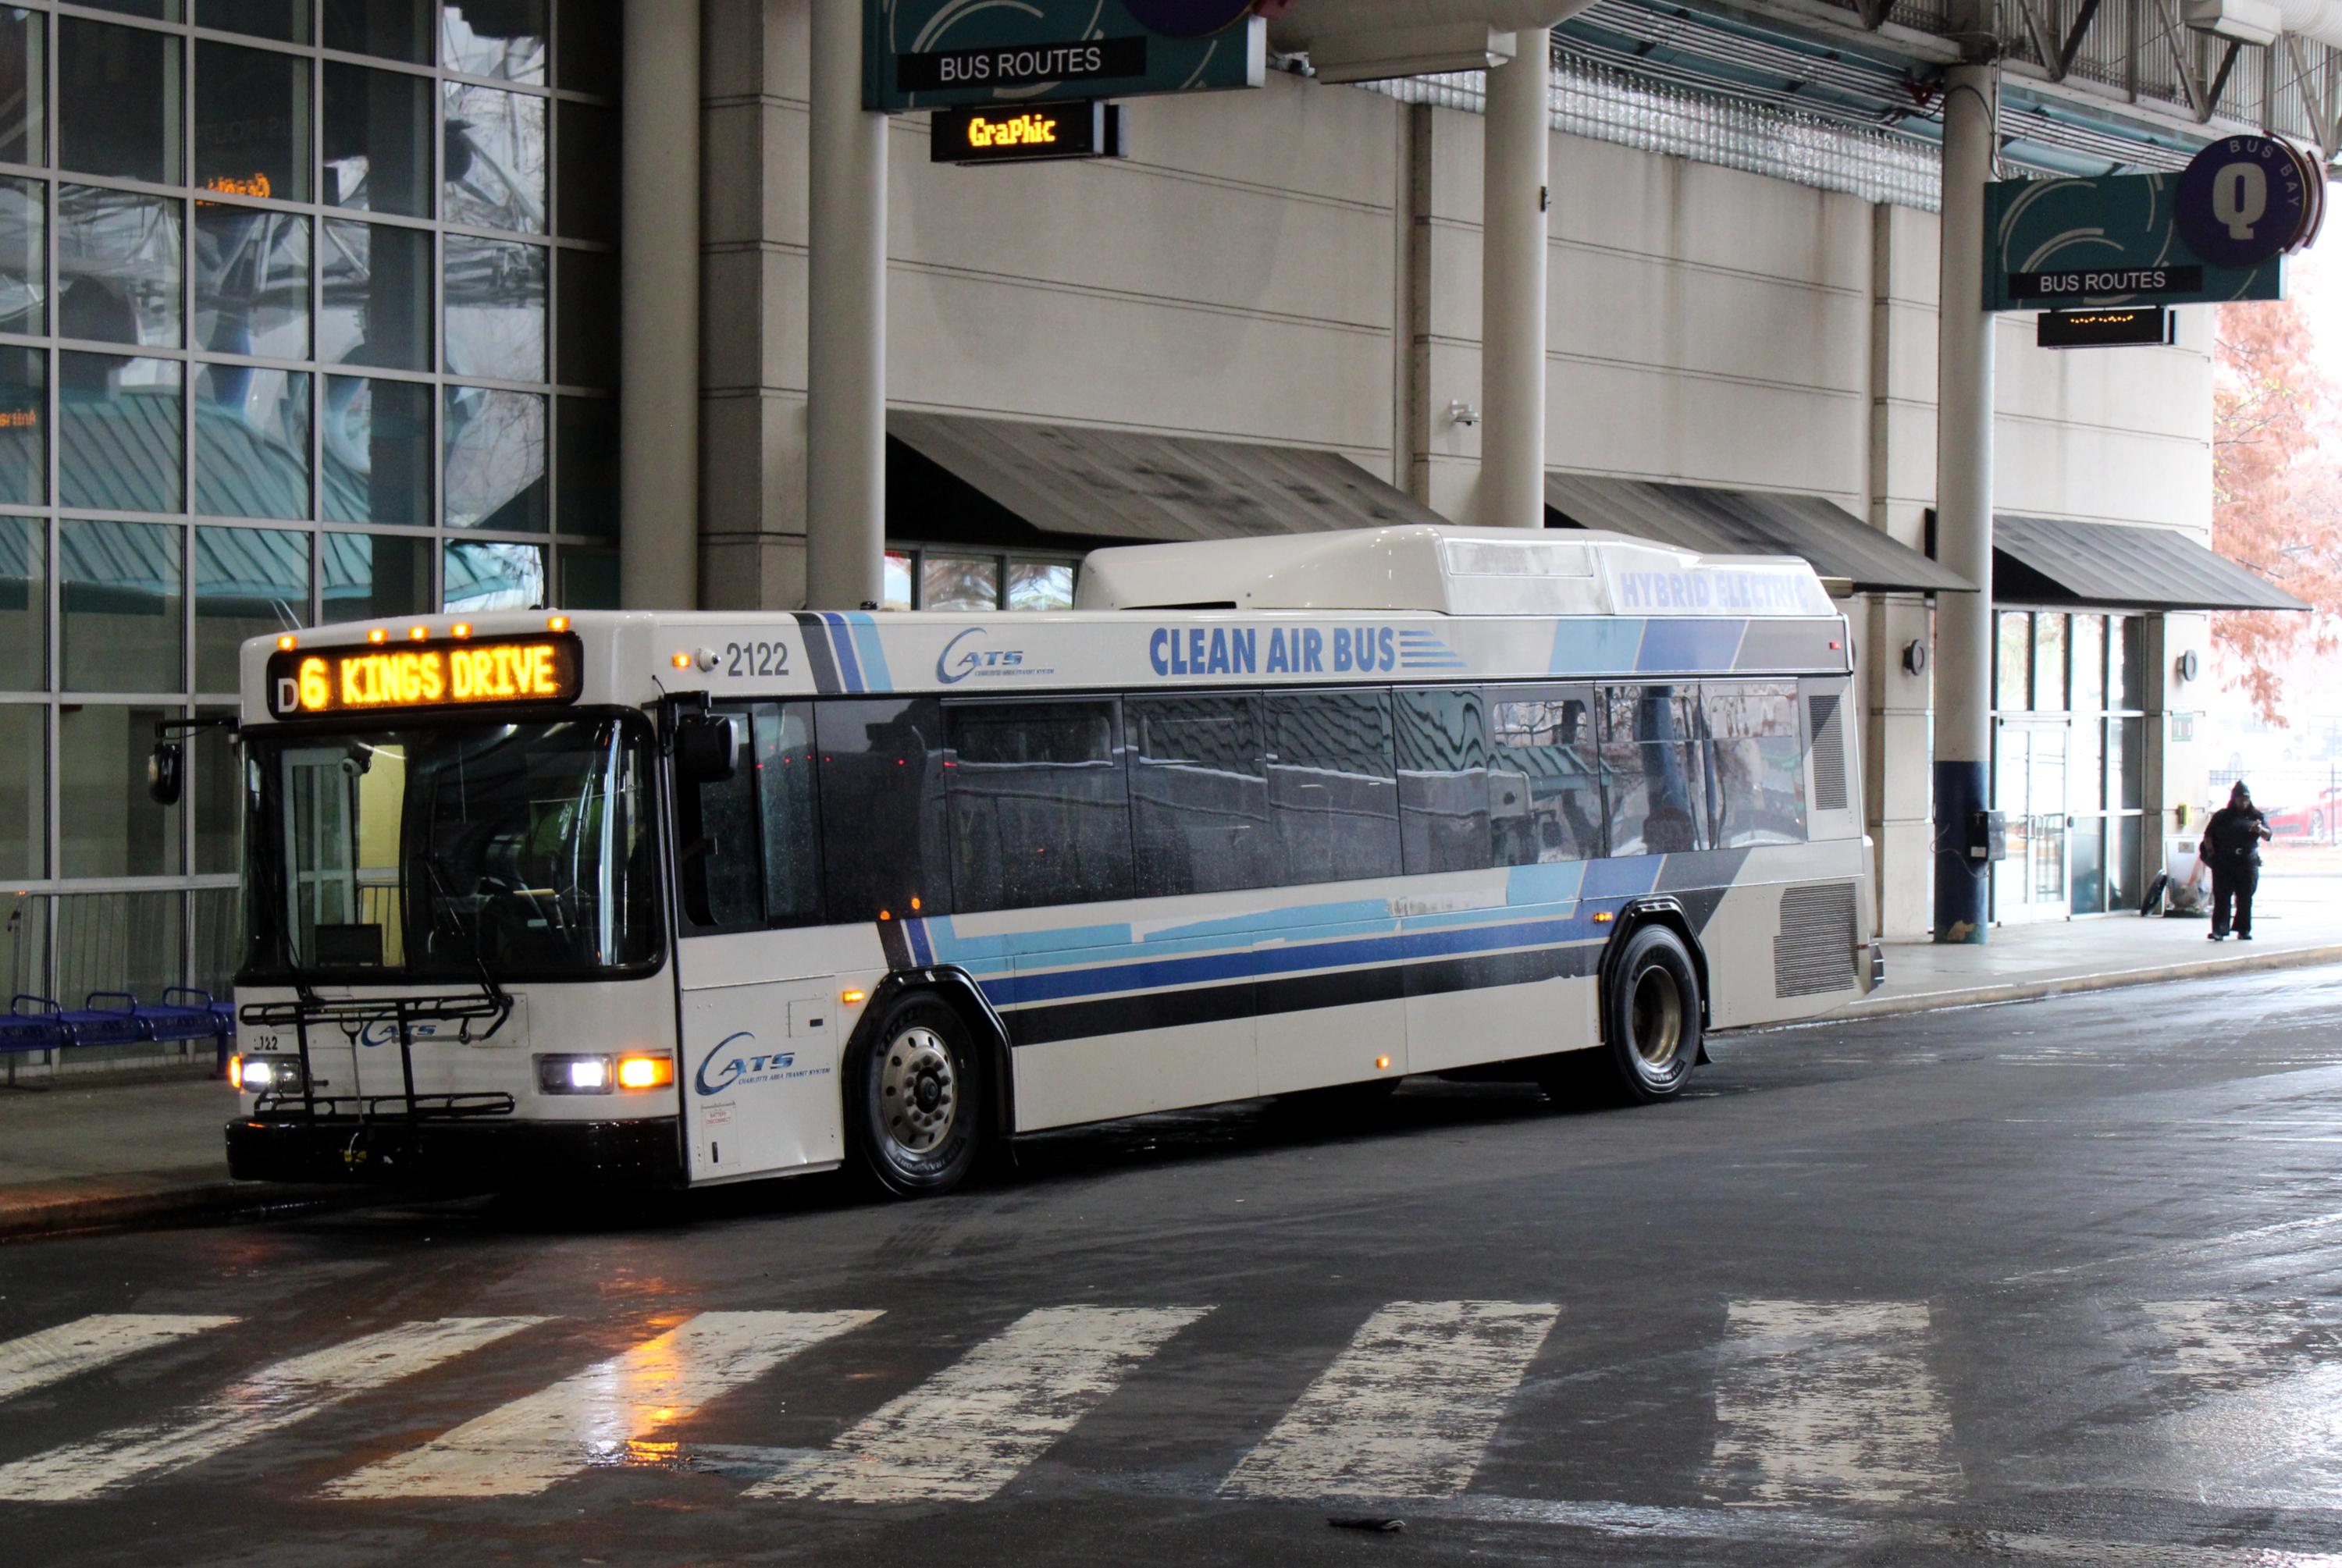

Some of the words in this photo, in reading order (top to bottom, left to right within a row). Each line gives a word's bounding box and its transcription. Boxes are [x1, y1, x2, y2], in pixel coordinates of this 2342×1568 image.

[941, 55, 990, 80] BUS
[998, 47, 1102, 76] ROUTES
[2230, 140, 2273, 158] BUS
[2280, 163, 2301, 208] BAY
[2212, 162, 2267, 240] Q
[2040, 275, 2079, 293] BUS
[2086, 272, 2166, 290] ROUTES
[1620, 572, 1710, 608] HYBRID
[1714, 573, 1812, 609] ELECTRIC
[299, 657, 328, 709] 6
[340, 652, 443, 704] KINGS
[450, 645, 556, 697] DRIVE
[727, 642, 789, 677] 2122
[936, 627, 1023, 684] CATS
[1150, 627, 1256, 676] CLEAN
[1266, 627, 1323, 674] AIR
[1333, 626, 1395, 673] BUS
[695, 1031, 795, 1096] CATS
